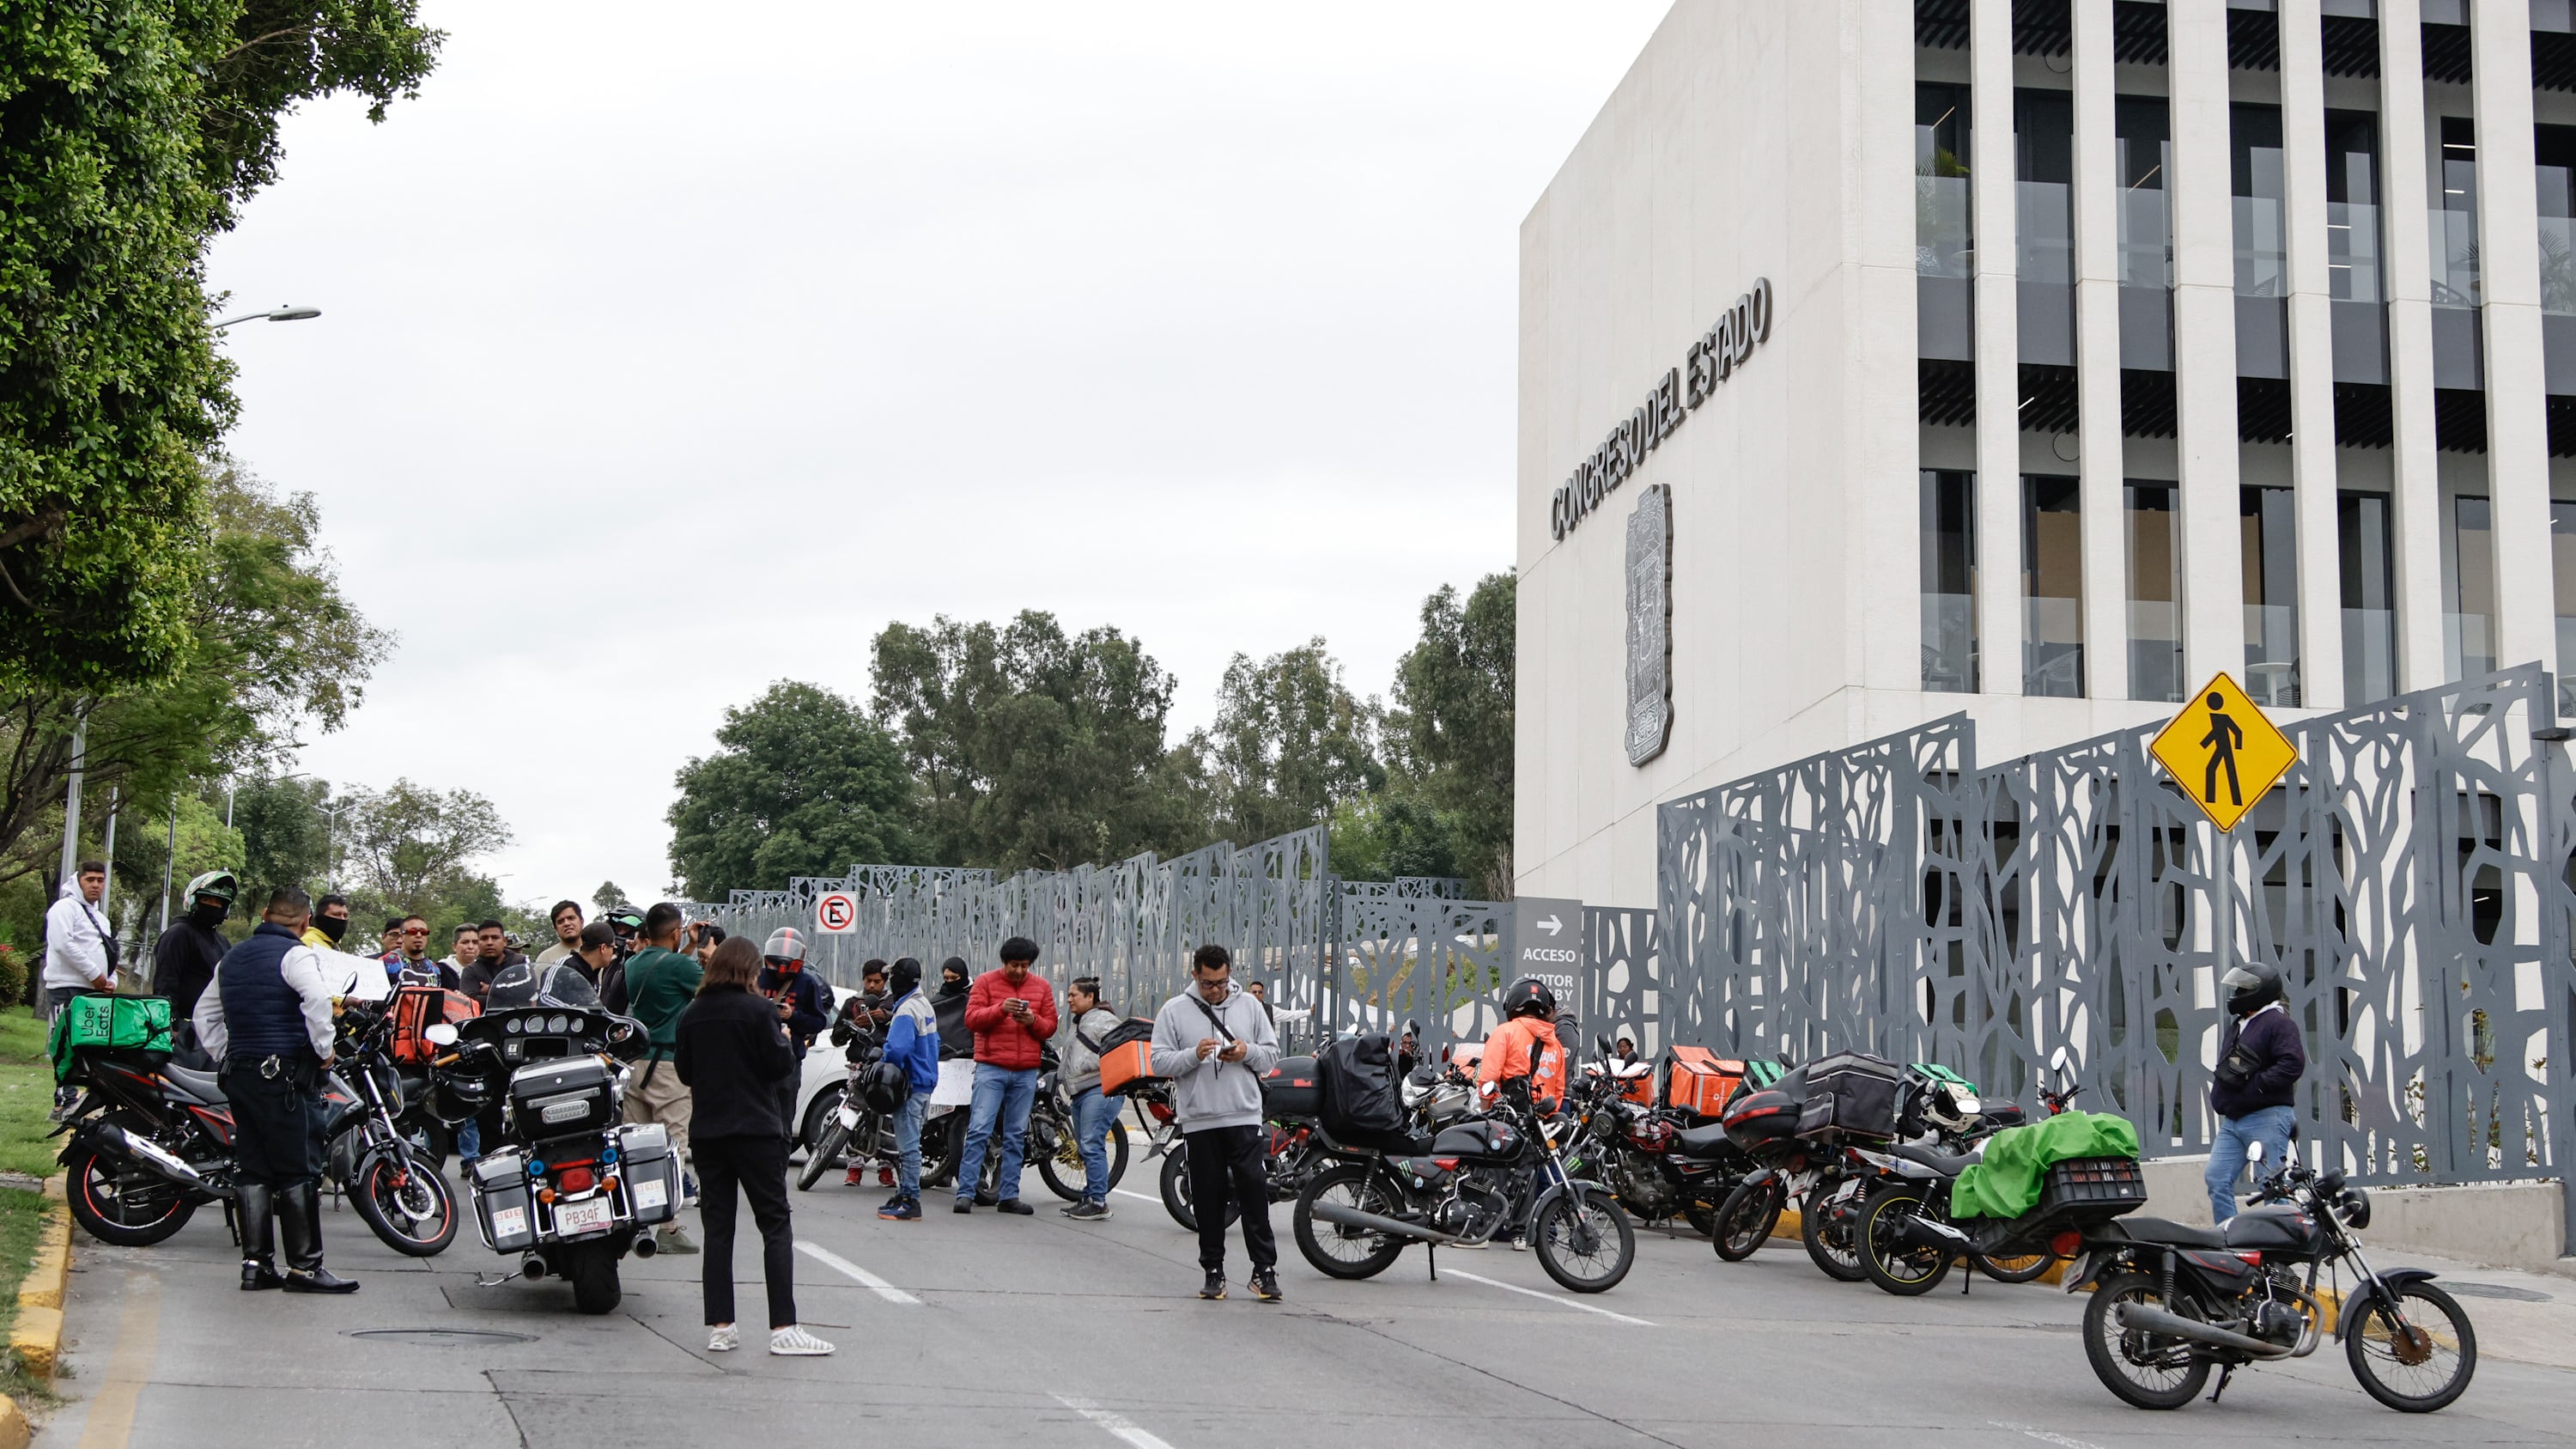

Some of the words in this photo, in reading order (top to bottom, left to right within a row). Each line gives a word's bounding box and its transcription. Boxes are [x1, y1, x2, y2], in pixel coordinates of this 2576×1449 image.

[1551, 406, 1646, 540] CONGRESO
[1645, 367, 1682, 451] DEL
[1686, 277, 1772, 411] ESTADO
[829, 902, 844, 923] E
[1522, 947, 1577, 963] ACCESO
[81, 1005, 94, 1037] Uber
[95, 1006, 110, 1038] Eats
[1526, 1044, 1558, 1066] ppi
[565, 1207, 599, 1227] PB34F
